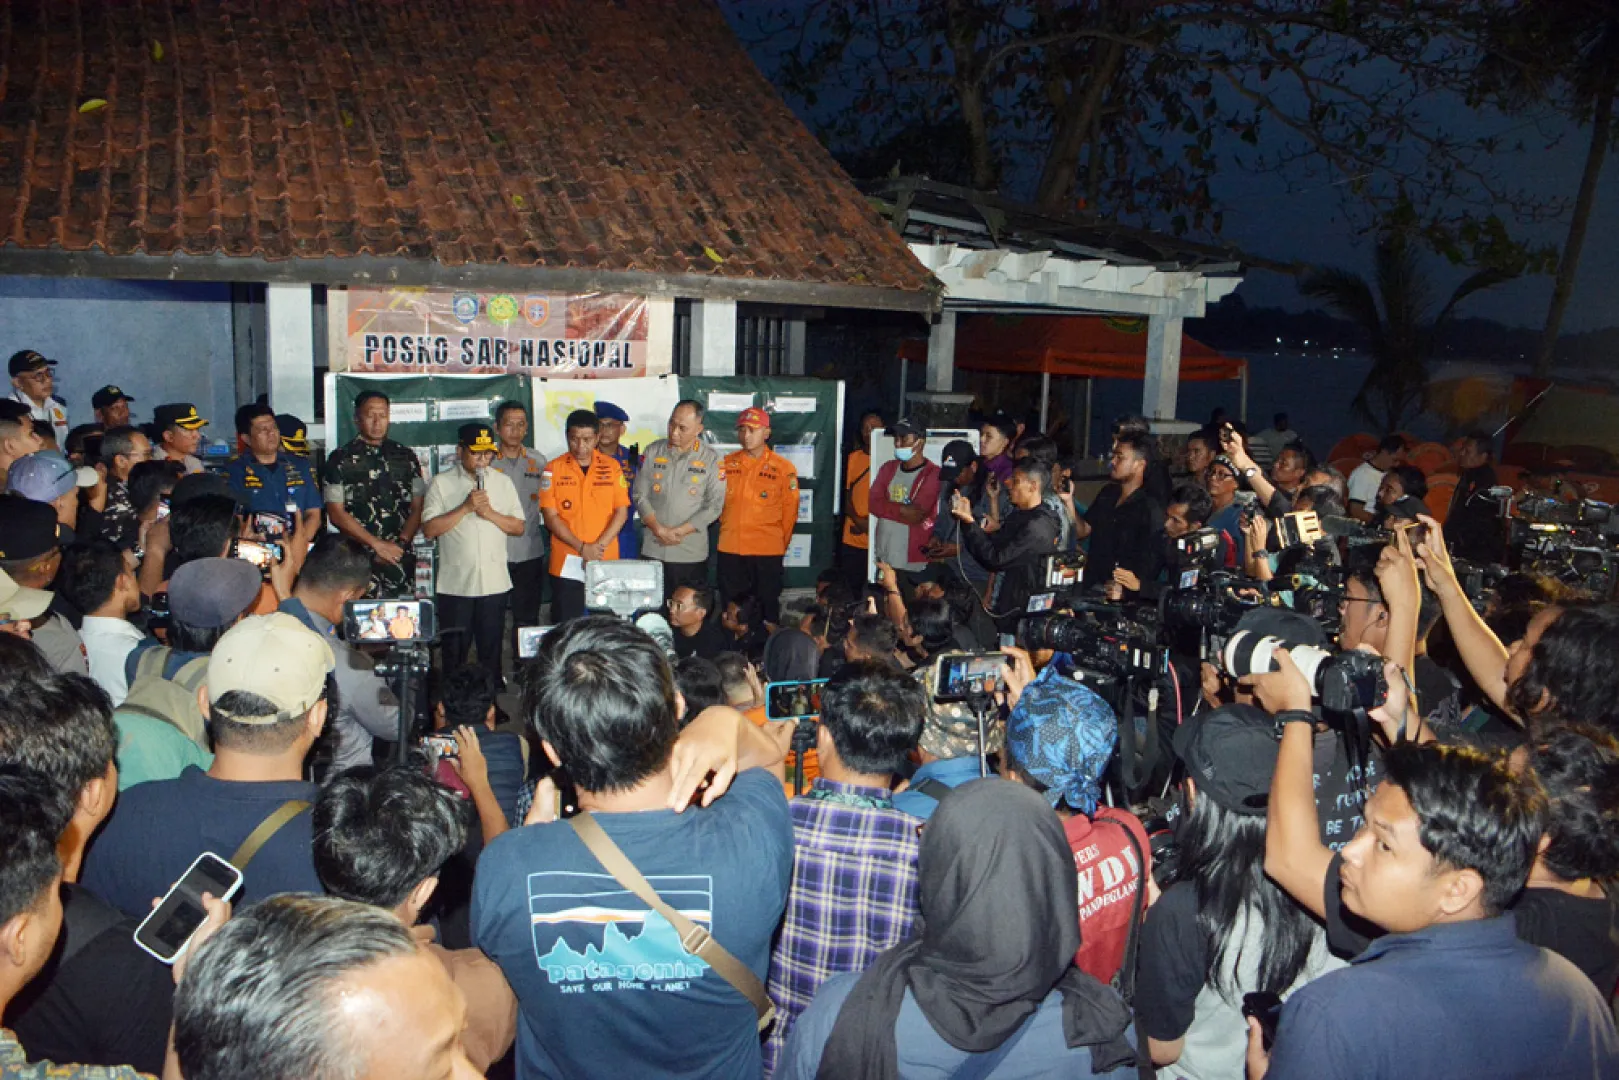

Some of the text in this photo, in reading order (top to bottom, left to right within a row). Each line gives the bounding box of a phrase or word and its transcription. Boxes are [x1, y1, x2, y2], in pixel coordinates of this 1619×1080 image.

[364, 334, 635, 369] POSKO SAR NASIONAL
[548, 959, 705, 984] patagonia
[560, 983, 586, 994] SAVE
[592, 981, 613, 992] OUR
